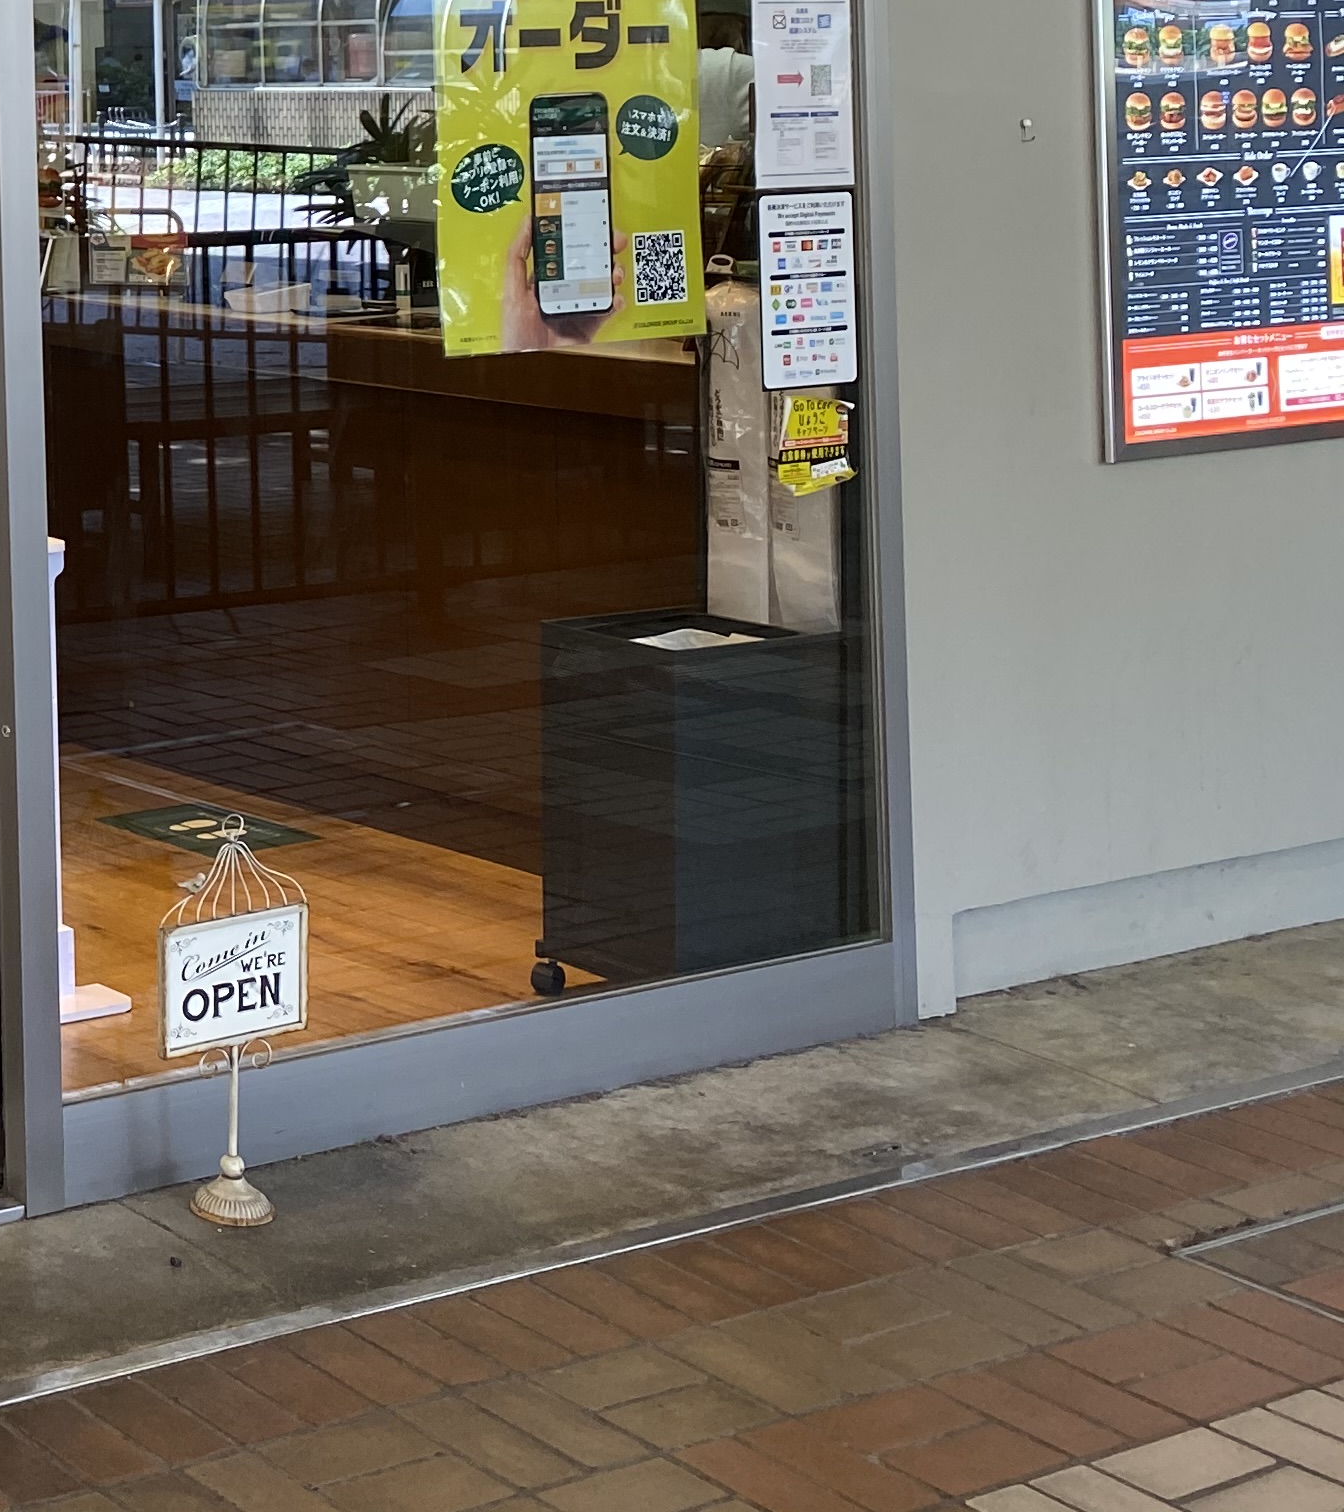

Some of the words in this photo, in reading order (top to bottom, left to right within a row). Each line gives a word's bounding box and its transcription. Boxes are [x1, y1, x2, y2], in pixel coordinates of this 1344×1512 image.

[480, 191, 500, 207] OK!
[181, 945, 239, 981] Come
[244, 930, 271, 948] in
[240, 950, 286, 972] WE'RE
[182, 972, 281, 1021] OPEN
